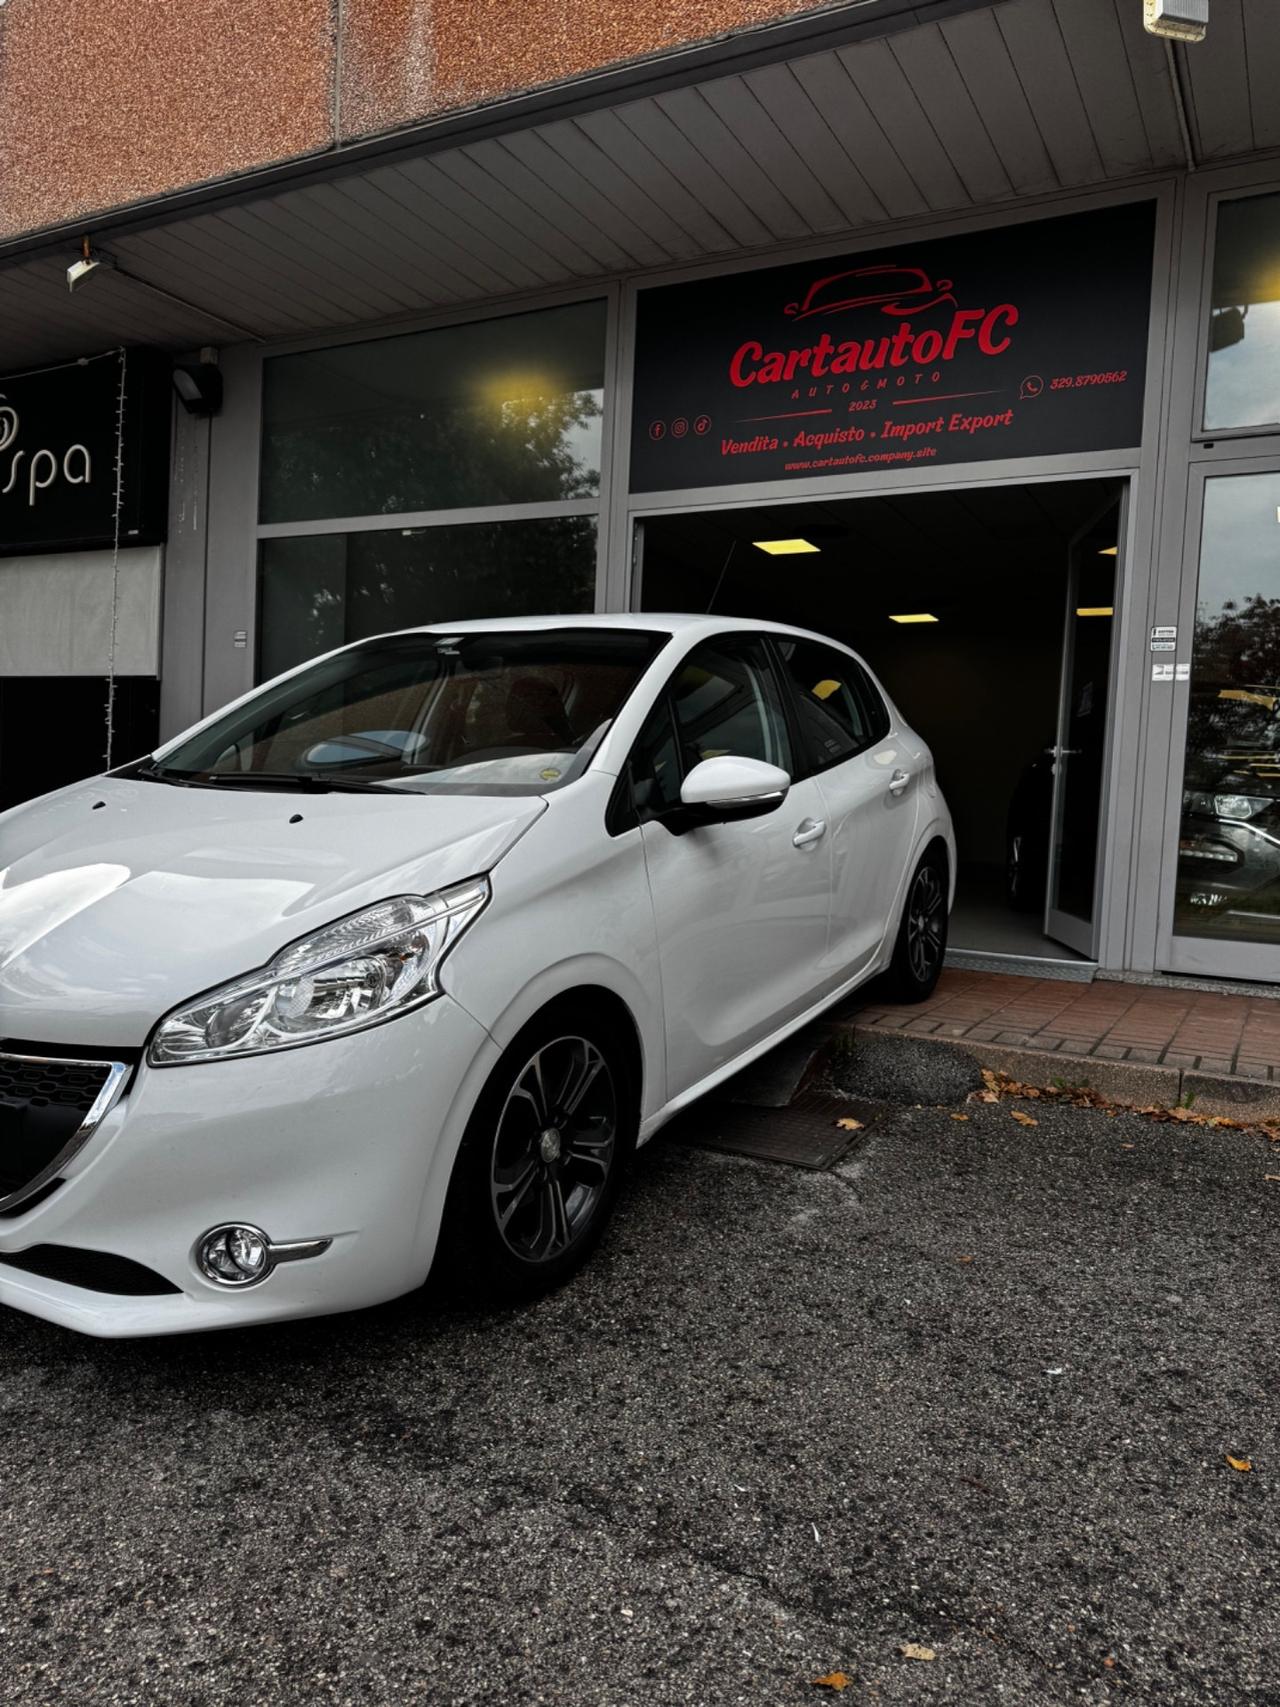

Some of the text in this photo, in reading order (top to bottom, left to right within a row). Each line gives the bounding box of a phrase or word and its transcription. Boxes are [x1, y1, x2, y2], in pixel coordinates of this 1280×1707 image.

[730, 304, 1018, 387] CartautoFC
[1050, 371, 1127, 389] 329.8790562
[848, 400, 877, 412] 2023
[721, 409, 1014, 456] Vendita Acquisto Import Export
[785, 447, 936, 471] www.cartautofc.company.site
